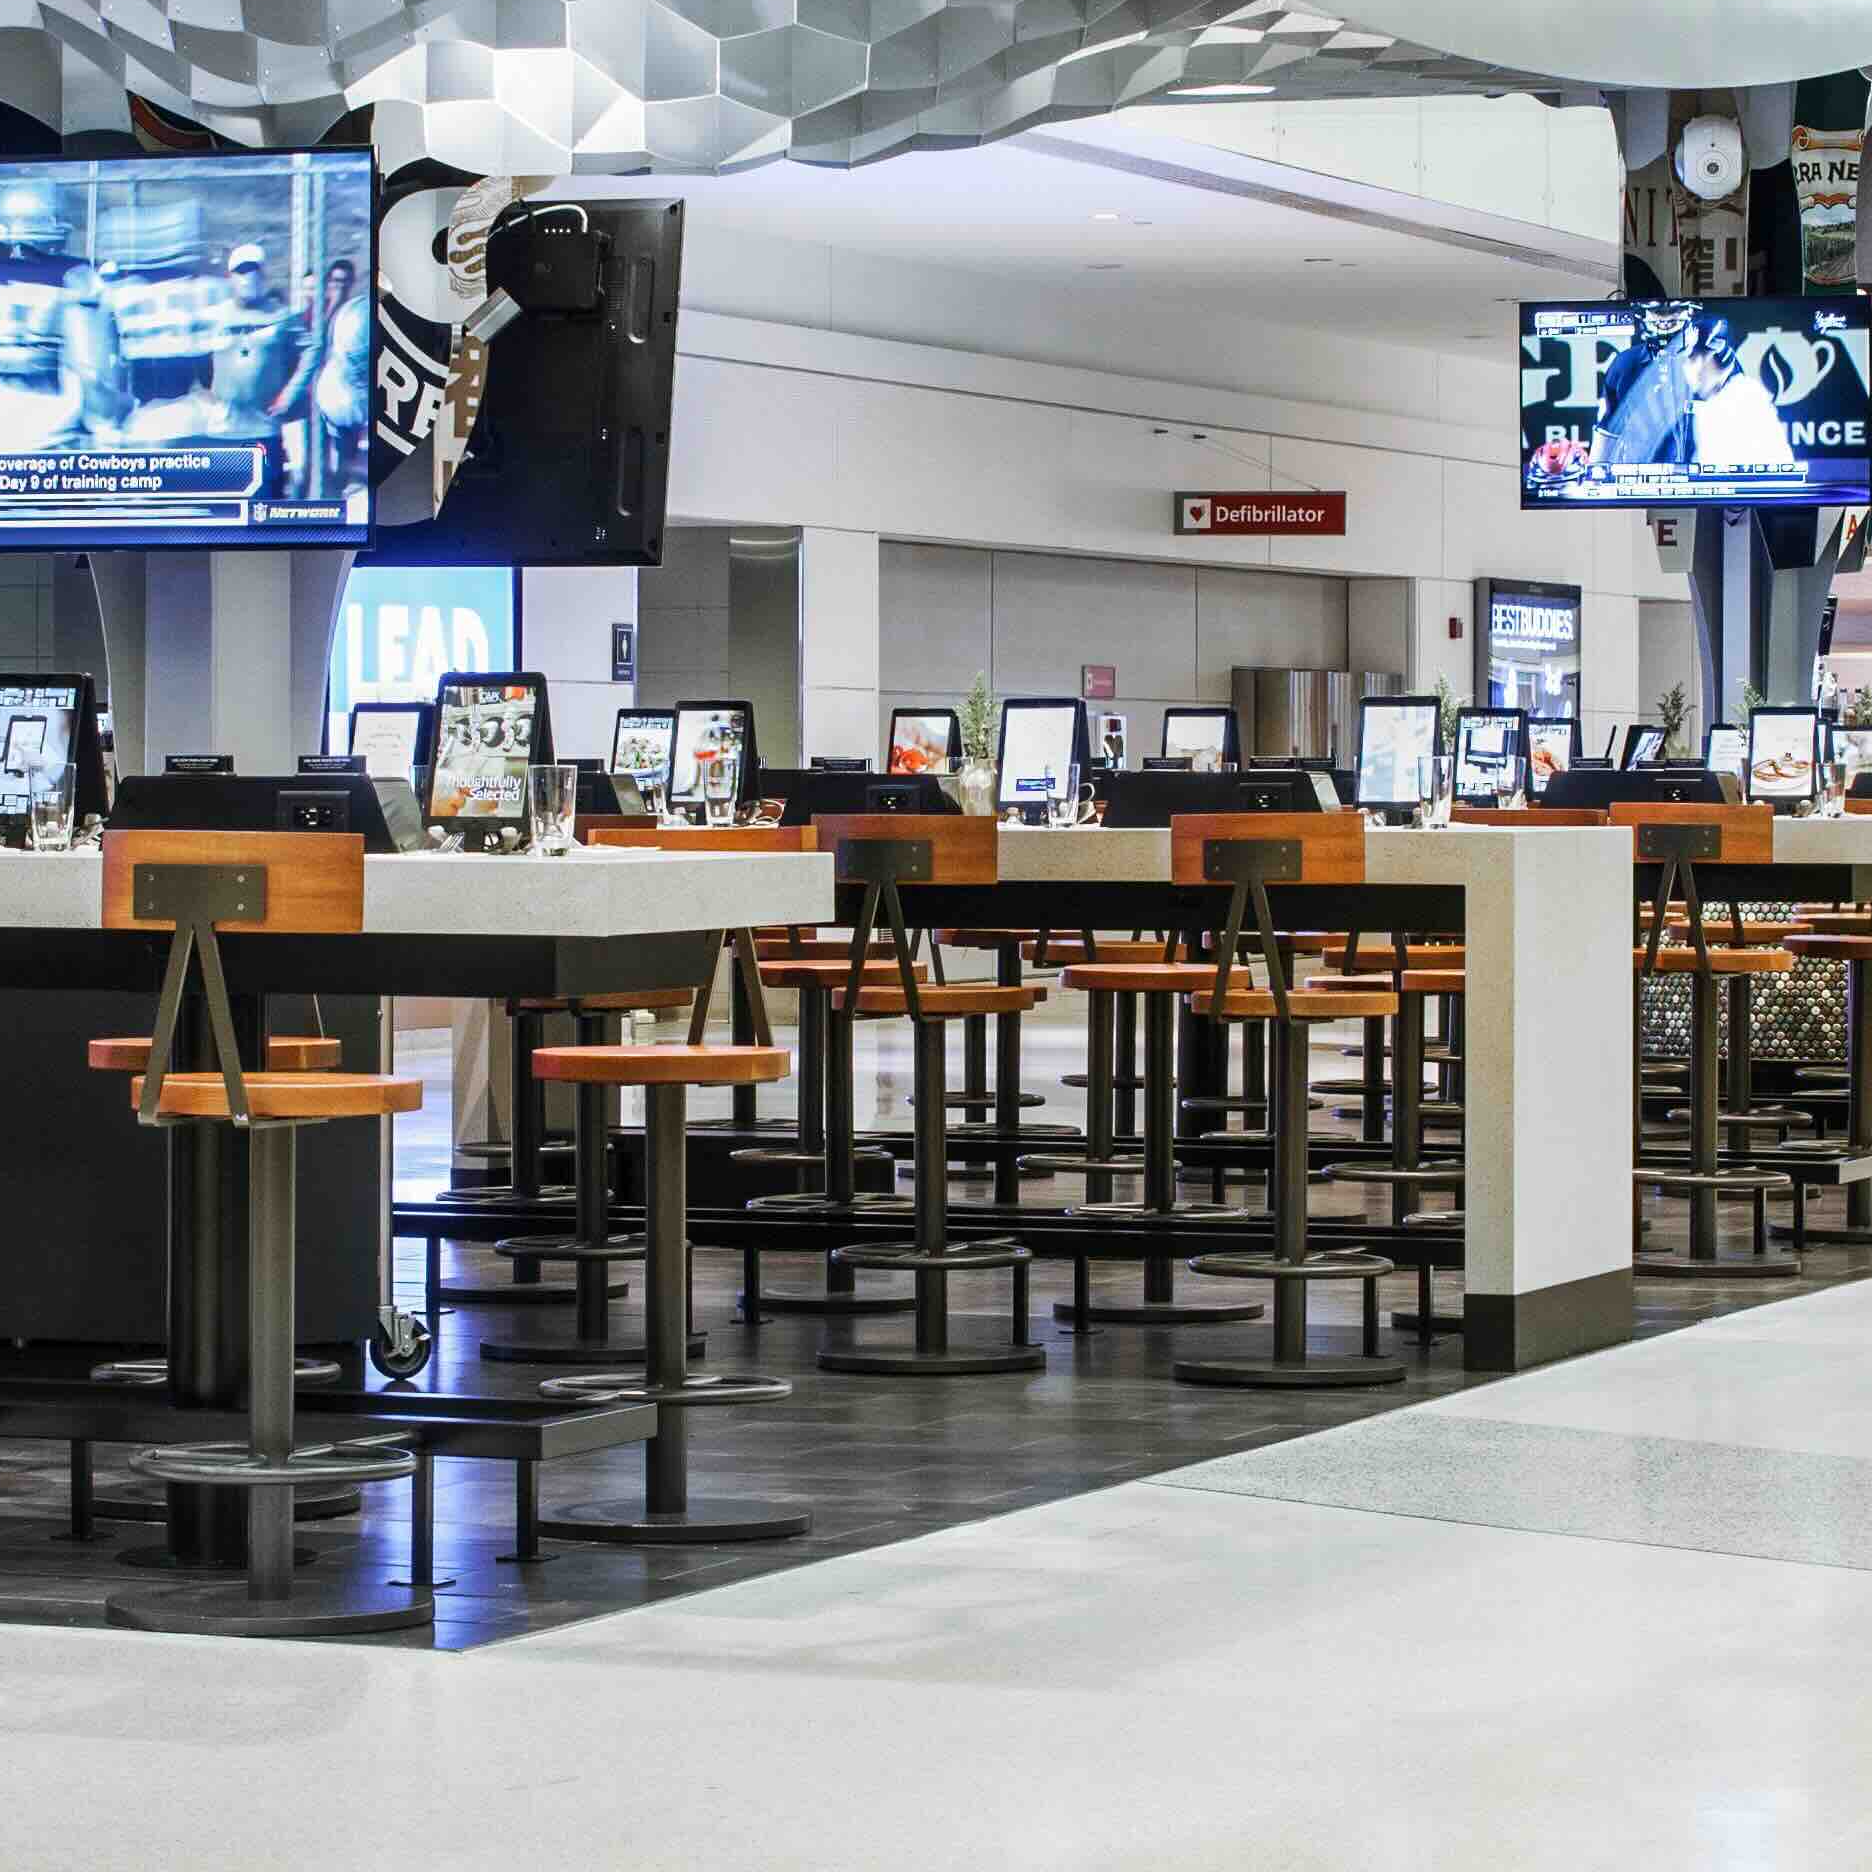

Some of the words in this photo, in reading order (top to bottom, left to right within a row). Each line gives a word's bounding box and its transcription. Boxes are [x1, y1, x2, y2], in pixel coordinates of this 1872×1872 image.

[59, 456, 76, 472] of
[77, 455, 147, 475] Cowboys
[150, 454, 211, 474] practice
[29, 474, 41, 490] 9
[43, 474, 59, 490] of
[60, 474, 118, 492] training
[120, 475, 164, 492] camp
[1215, 505, 1326, 522] Defibrillator
[346, 602, 489, 696] LEAD
[469, 787, 521, 802] Selected
